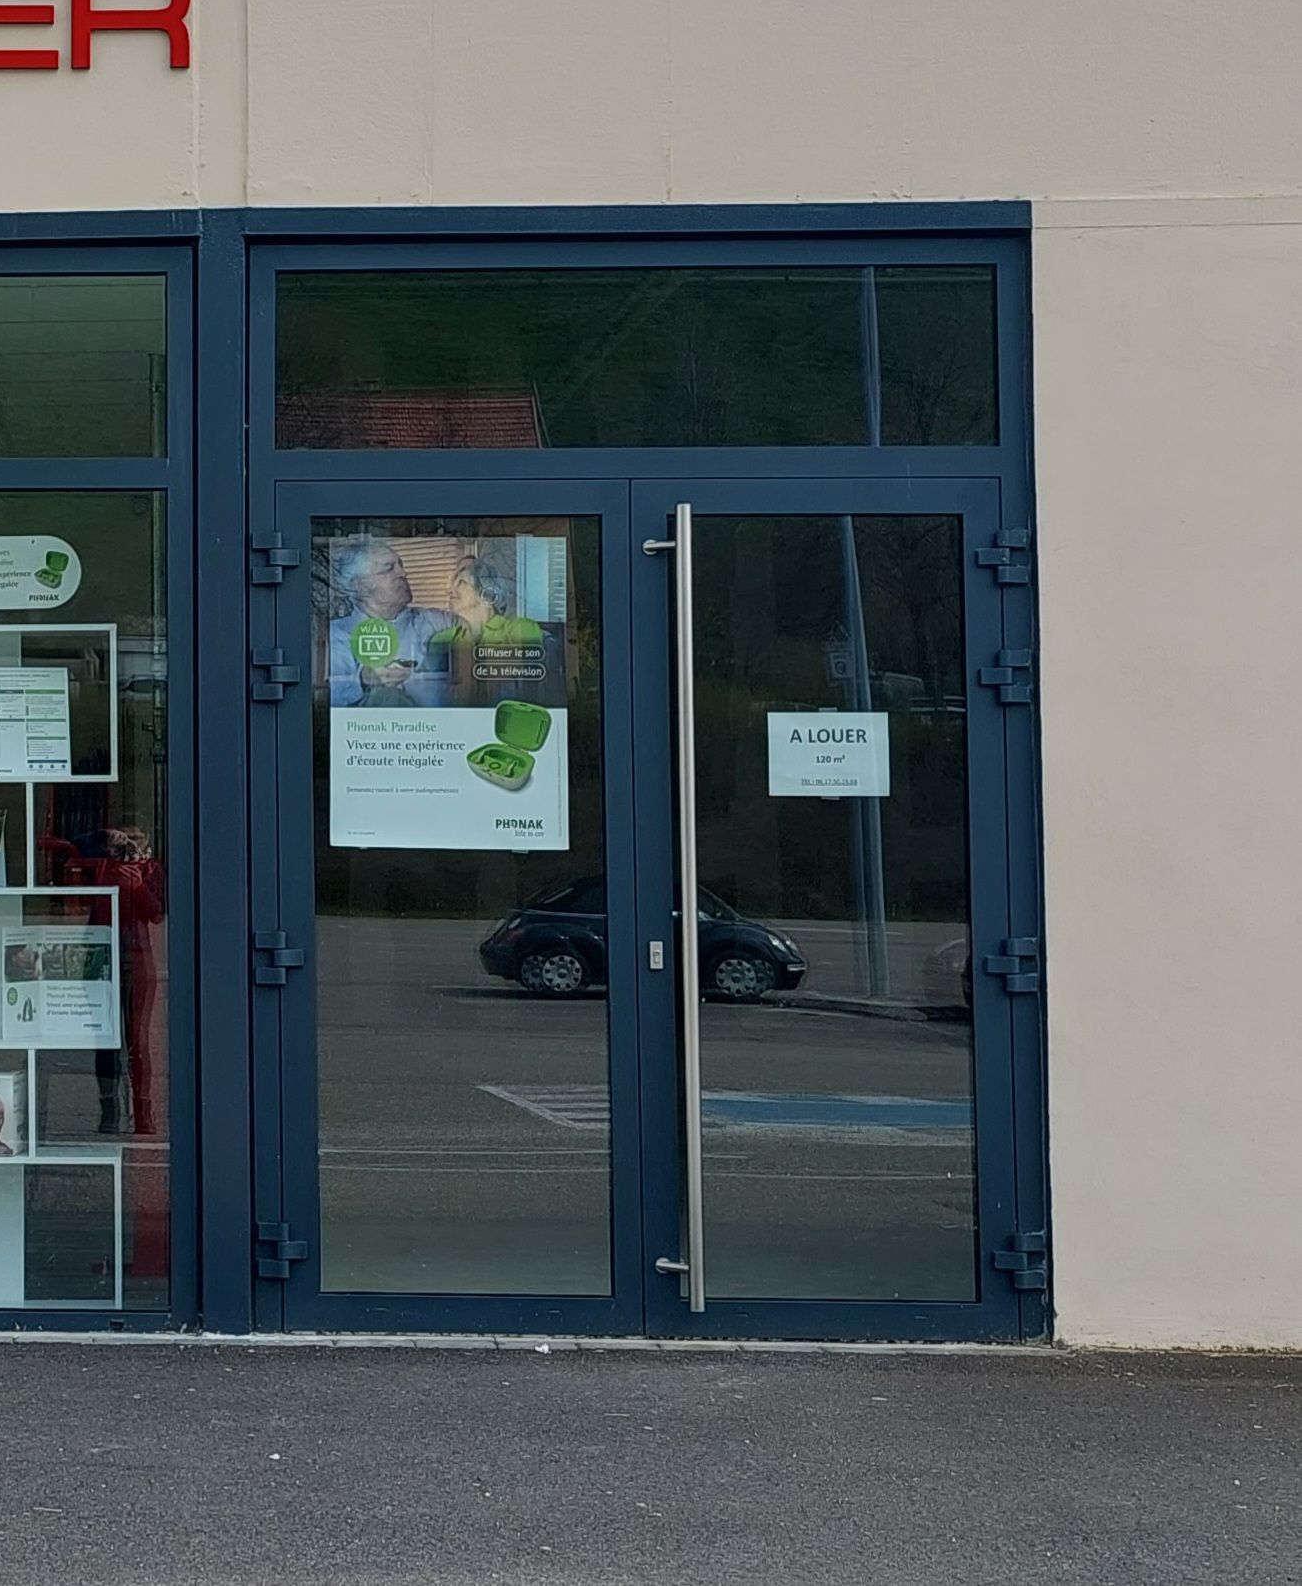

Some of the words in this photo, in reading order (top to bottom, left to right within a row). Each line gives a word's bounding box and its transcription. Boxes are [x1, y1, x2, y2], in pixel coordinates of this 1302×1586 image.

[360, 626, 371, 634] VU
[380, 626, 389, 634] LA
[364, 639, 385, 652] TV
[478, 647, 512, 658] Diffuser
[514, 648, 523, 658] le
[525, 649, 540, 658] son
[476, 666, 488, 677] de
[490, 666, 499, 677] la
[500, 665, 543, 677] télévision
[346, 721, 388, 733] Phonak
[391, 721, 437, 733] Paradise
[789, 728, 803, 744] A
[808, 728, 868, 744] LOUER
[346, 739, 377, 751] Vivez
[381, 741, 402, 751] une
[405, 738, 466, 754] expérience
[398, 754, 445, 769] inégalée
[815, 755, 832, 764] 120
[495, 818, 544, 830] PHONAK
